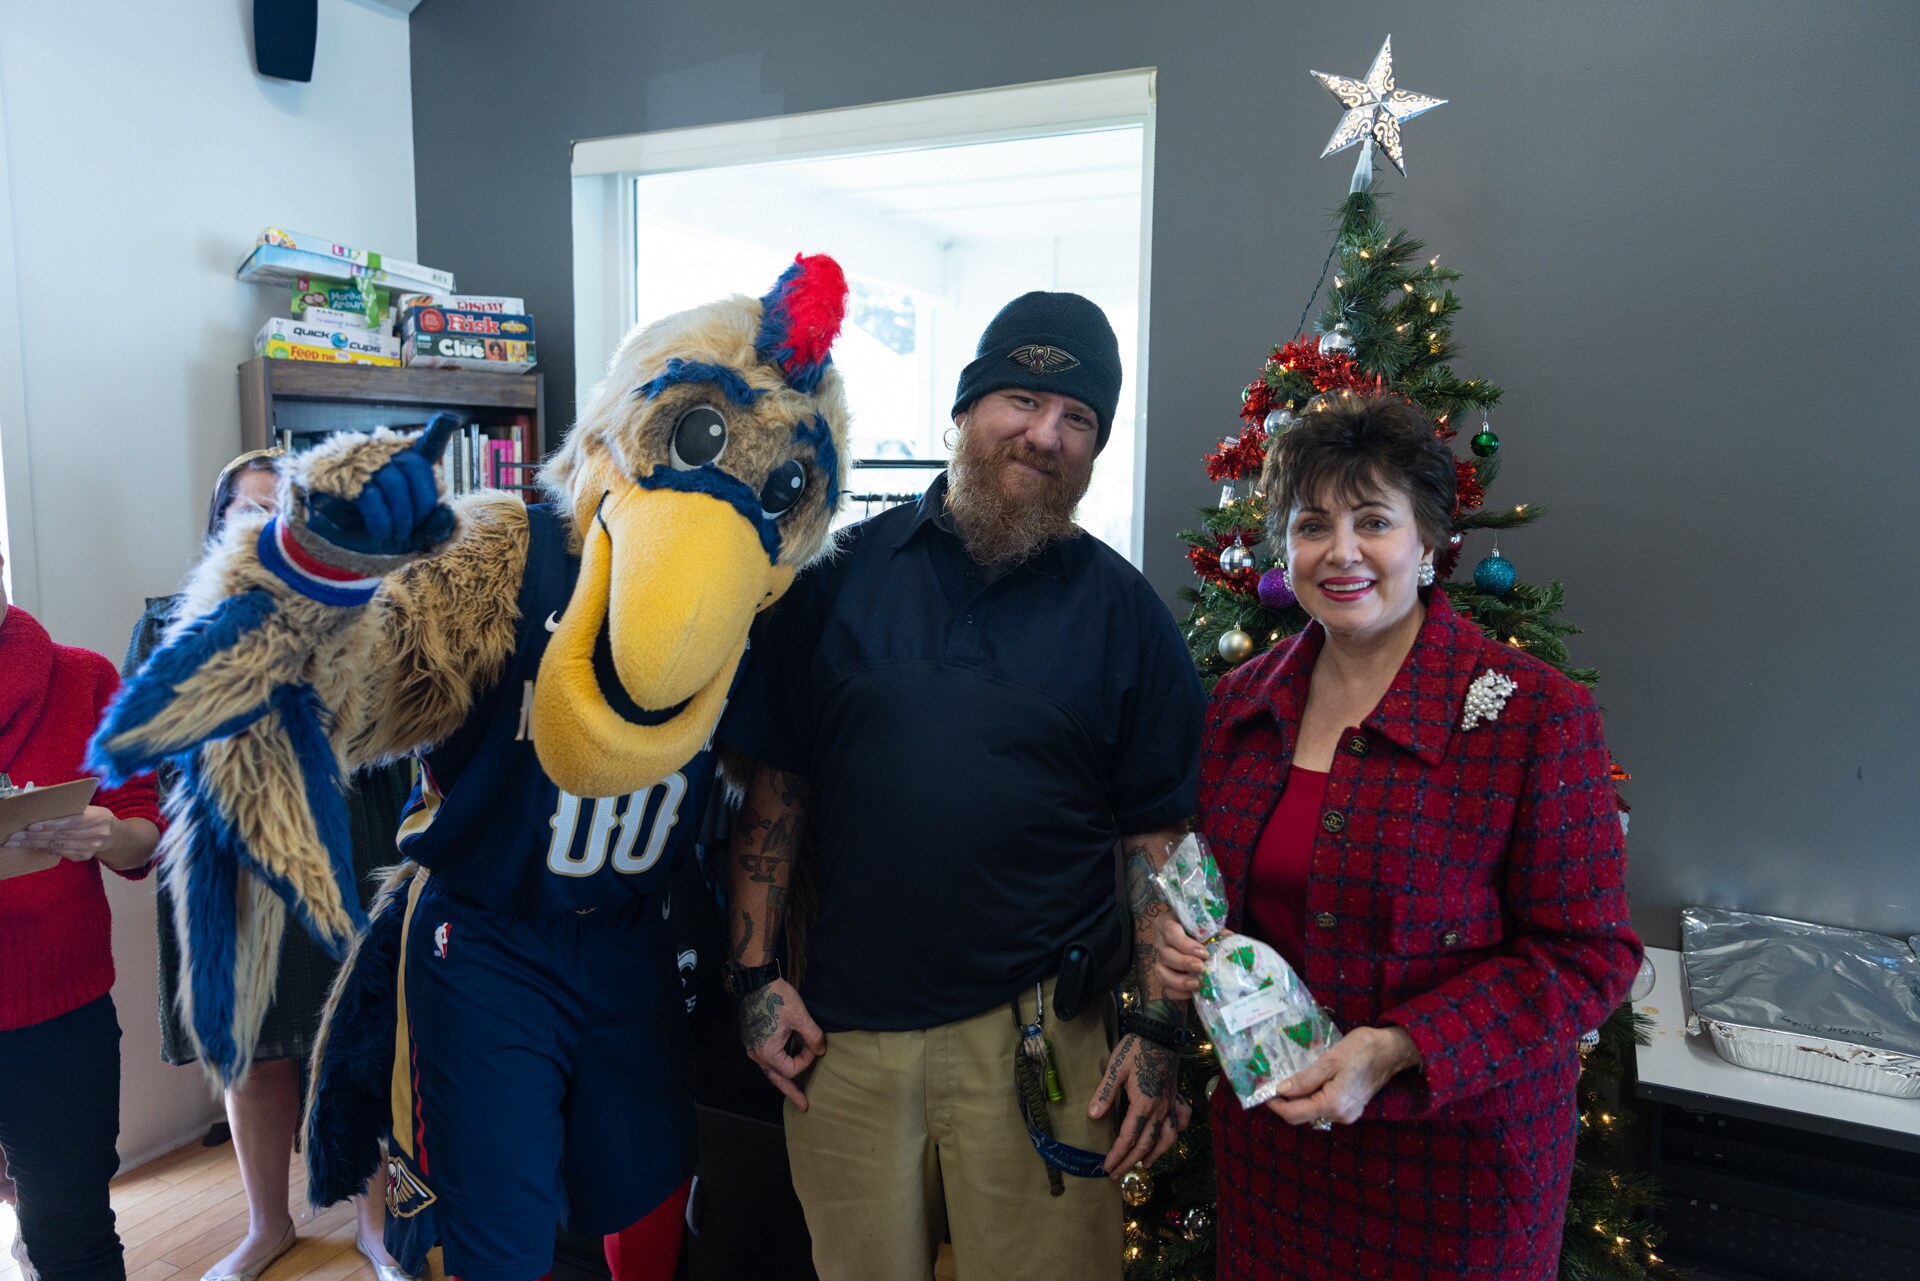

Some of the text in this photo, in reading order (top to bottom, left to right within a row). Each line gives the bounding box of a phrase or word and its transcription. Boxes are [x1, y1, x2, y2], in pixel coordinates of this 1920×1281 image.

[331, 291, 363, 302] Monke
[333, 300, 365, 310] Aroun
[446, 313, 500, 335] Risk
[438, 338, 485, 359] Clue
[546, 770, 688, 878] 00
